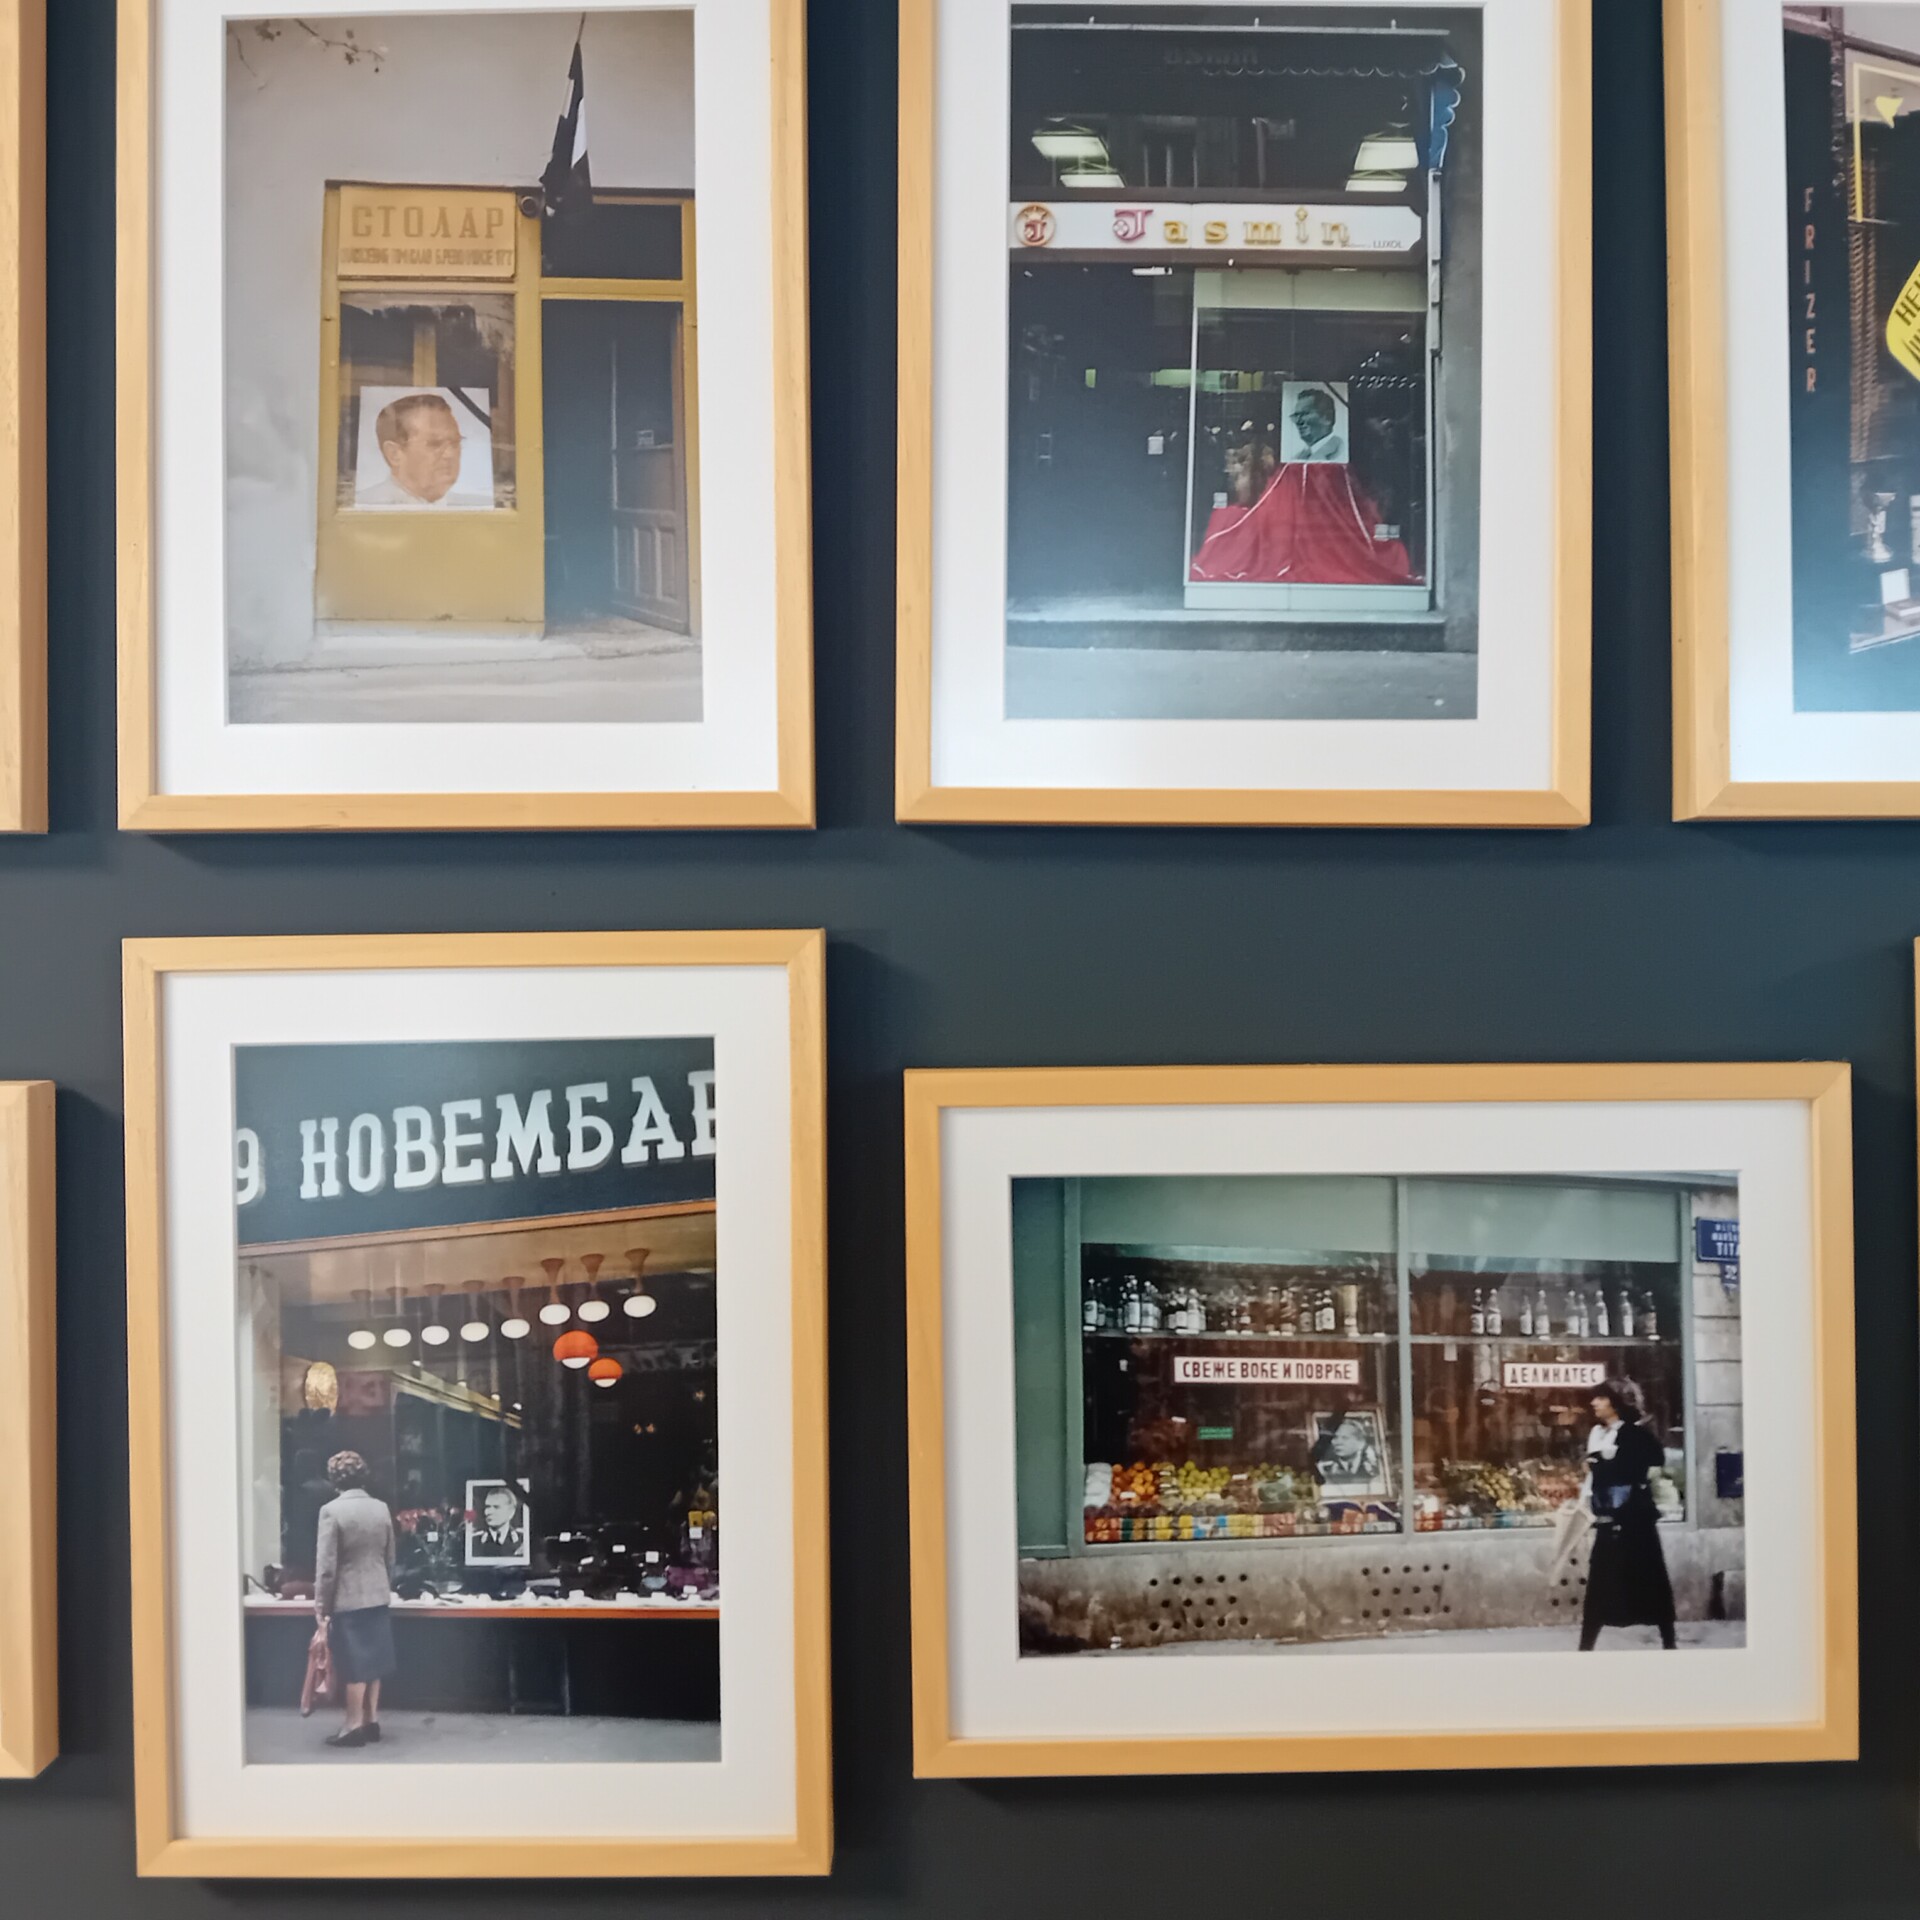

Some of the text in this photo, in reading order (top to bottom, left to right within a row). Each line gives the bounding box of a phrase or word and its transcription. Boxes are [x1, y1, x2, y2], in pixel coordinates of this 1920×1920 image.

[351, 205, 504, 239] СТОЛАР
[1113, 207, 1350, 246] Jasmin
[236, 1127, 265, 1206] 9
[1182, 1361, 1236, 1378] СВЕЖЕ
[1283, 1363, 1292, 1379] И
